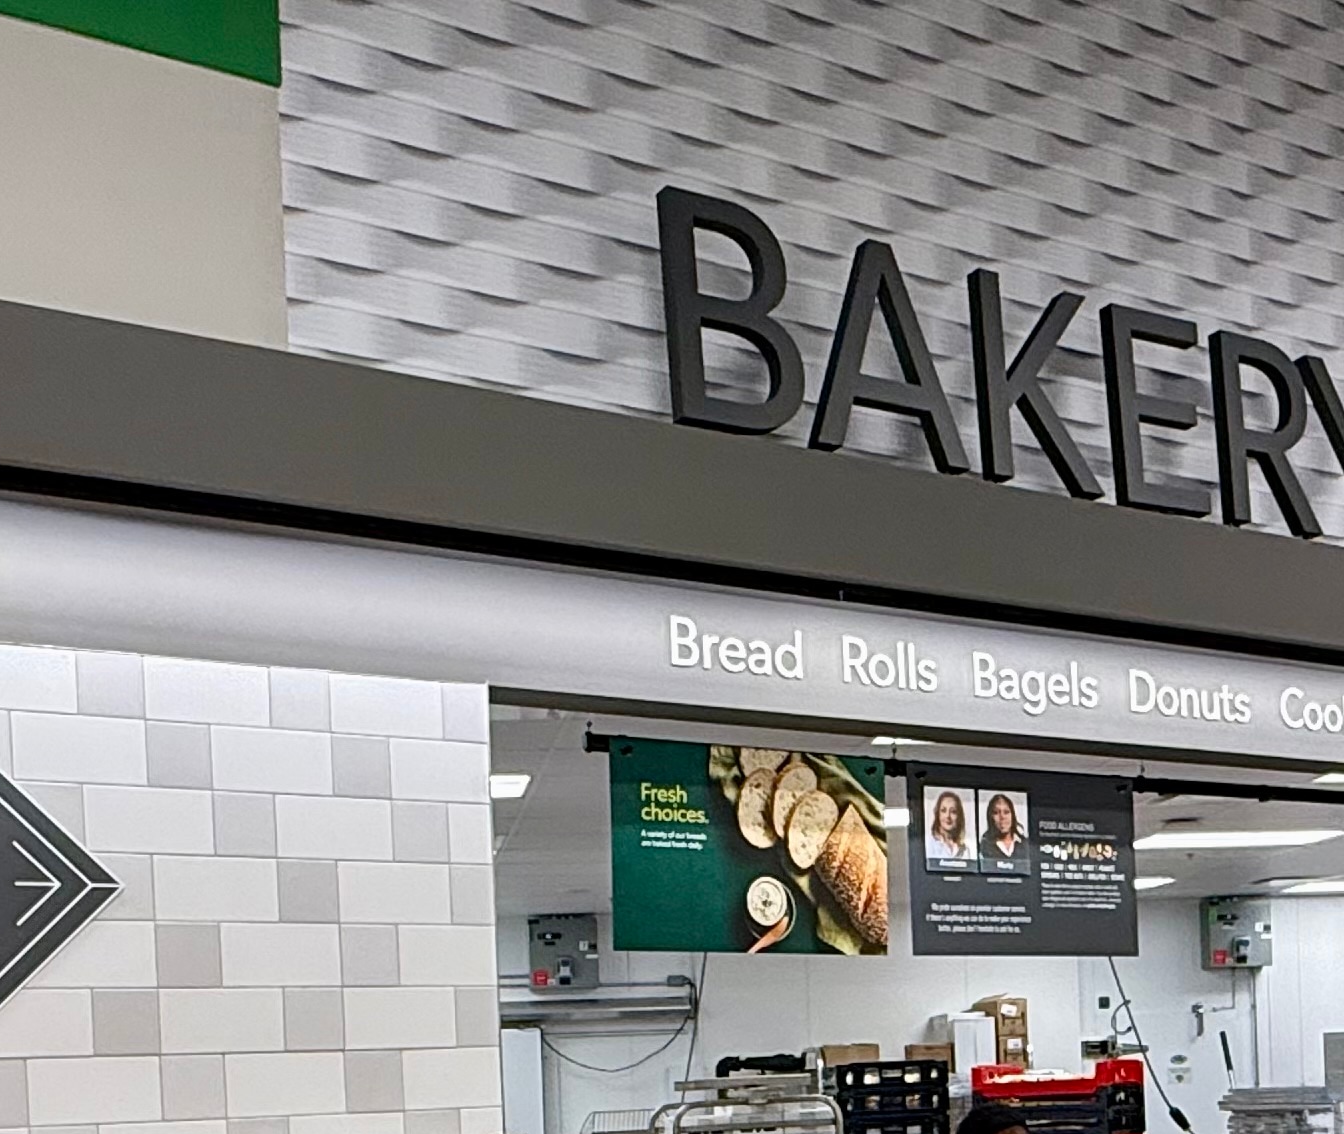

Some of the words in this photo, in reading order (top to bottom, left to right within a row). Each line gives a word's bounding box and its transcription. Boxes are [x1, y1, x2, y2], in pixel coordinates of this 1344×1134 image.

[668, 614, 805, 681] Bread
[840, 634, 939, 693] Rolls
[971, 650, 1100, 716] Bagels
[1127, 667, 1253, 725] Donuts
[640, 782, 688, 804] Fresh
[640, 803, 710, 825] choices.
